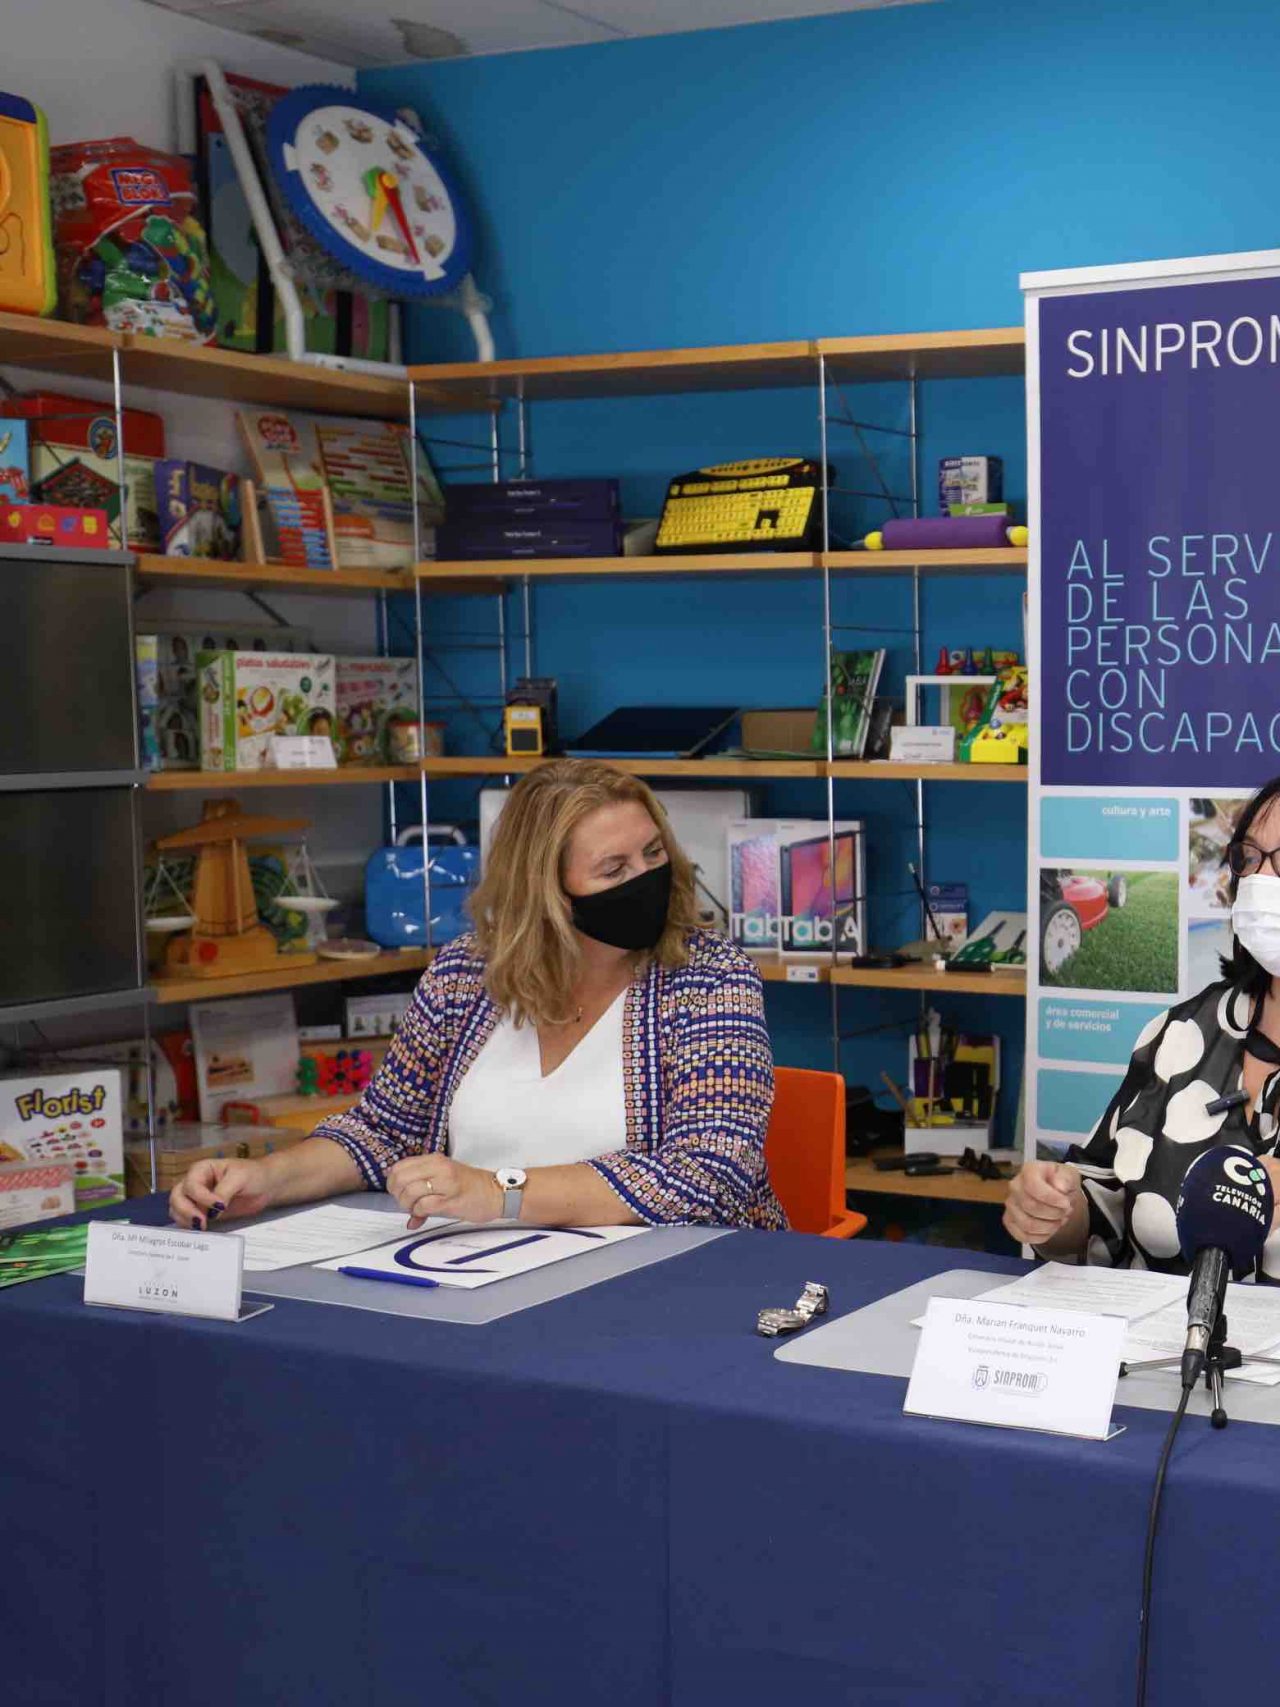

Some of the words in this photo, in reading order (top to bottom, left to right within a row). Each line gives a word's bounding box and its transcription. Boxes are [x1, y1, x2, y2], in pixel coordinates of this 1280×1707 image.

[1066, 538, 1125, 580] AL
[1067, 581, 1125, 624] DE
[1152, 577, 1249, 621] LAS
[1066, 668, 1166, 710] CON
[1101, 804, 1139, 817] cultura
[1139, 807, 1147, 819] y
[1148, 805, 1172, 817] arte
[732, 912, 779, 938] Tab
[780, 915, 834, 943] Tab
[840, 917, 862, 943] A
[1045, 1005, 1068, 1019] área
[1069, 1008, 1120, 1021] comercial
[1046, 1019, 1053, 1031] y
[1053, 1018, 1067, 1030] de
[1067, 1020, 1112, 1033] servicios
[15, 1084, 107, 1122] Florist
[1212, 1191, 1267, 1226] CANARIA
[1215, 1184, 1263, 1209] TELEVISIÓN
[138, 1286, 179, 1299] LUZON
[1008, 1319, 1048, 1334] Franquet
[1049, 1325, 1086, 1338] Navarro
